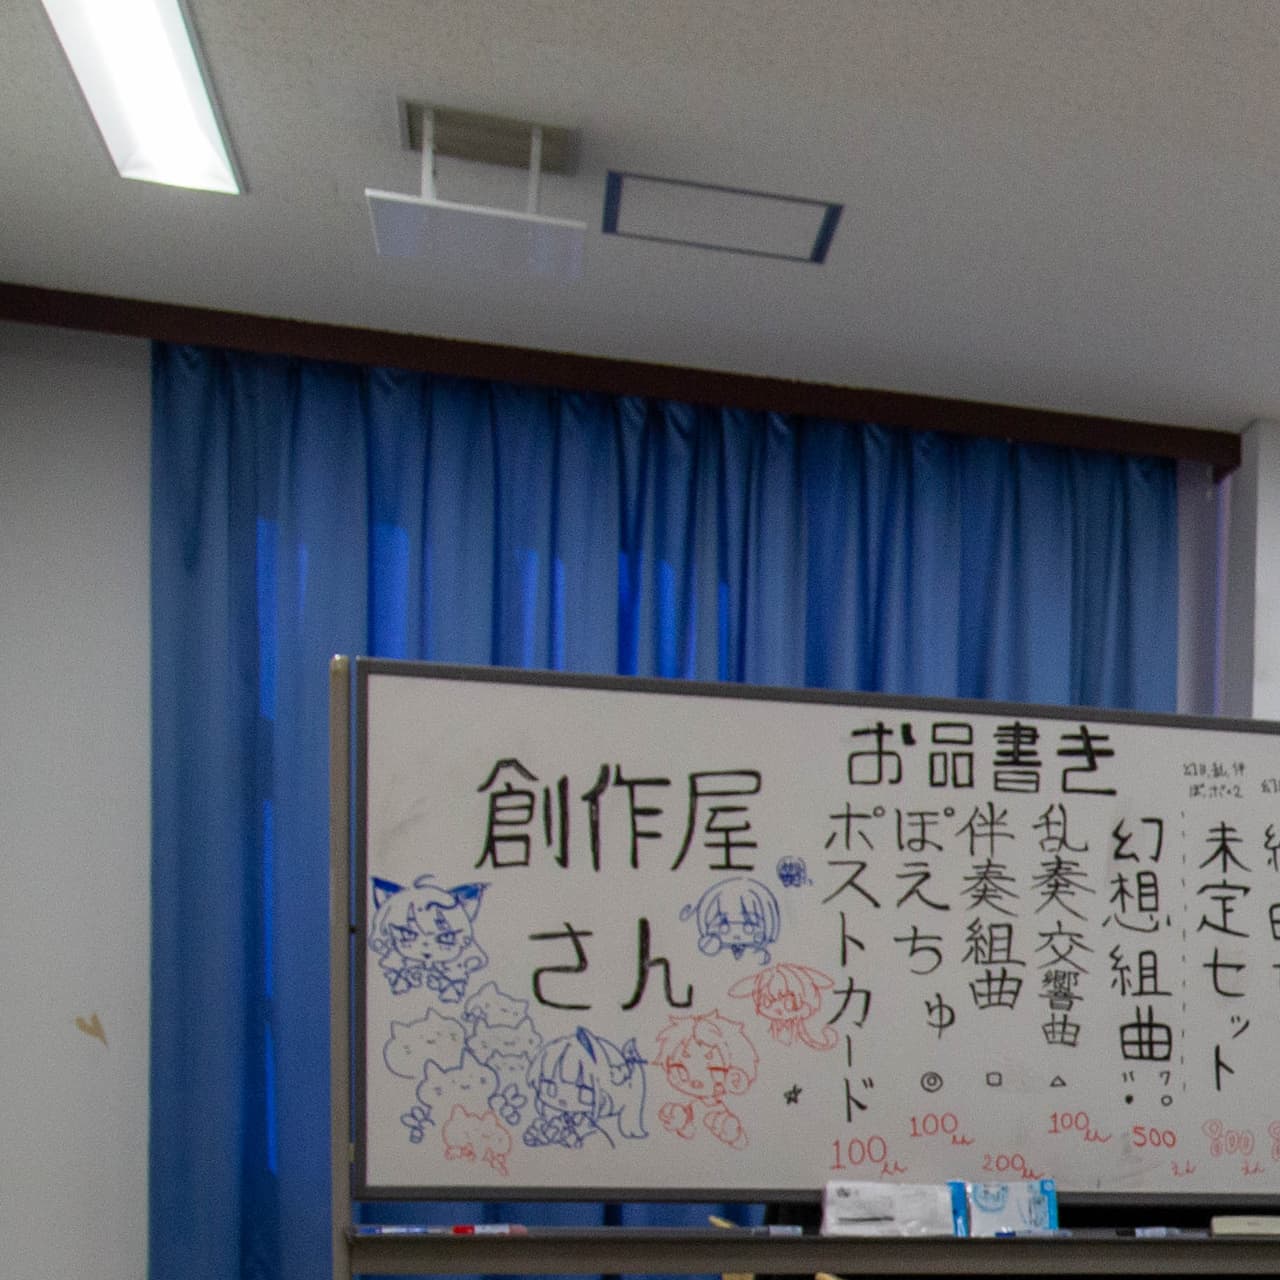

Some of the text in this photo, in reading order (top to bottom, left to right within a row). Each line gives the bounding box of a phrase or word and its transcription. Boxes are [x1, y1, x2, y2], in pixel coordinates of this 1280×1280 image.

[474, 758, 762, 872] 創作屋
[848, 721, 1118, 796] お品書き
[528, 917, 693, 1011] さん
[822, 801, 886, 1122] ポストカード
[893, 804, 956, 1039] ぽえちゅ
[955, 801, 1027, 1010] 伴奏組曲
[1032, 803, 1097, 1048] 乱奏交響曲
[1101, 816, 1174, 1062] 幻想組曲
[1196, 821, 1252, 1092] 未定セット
